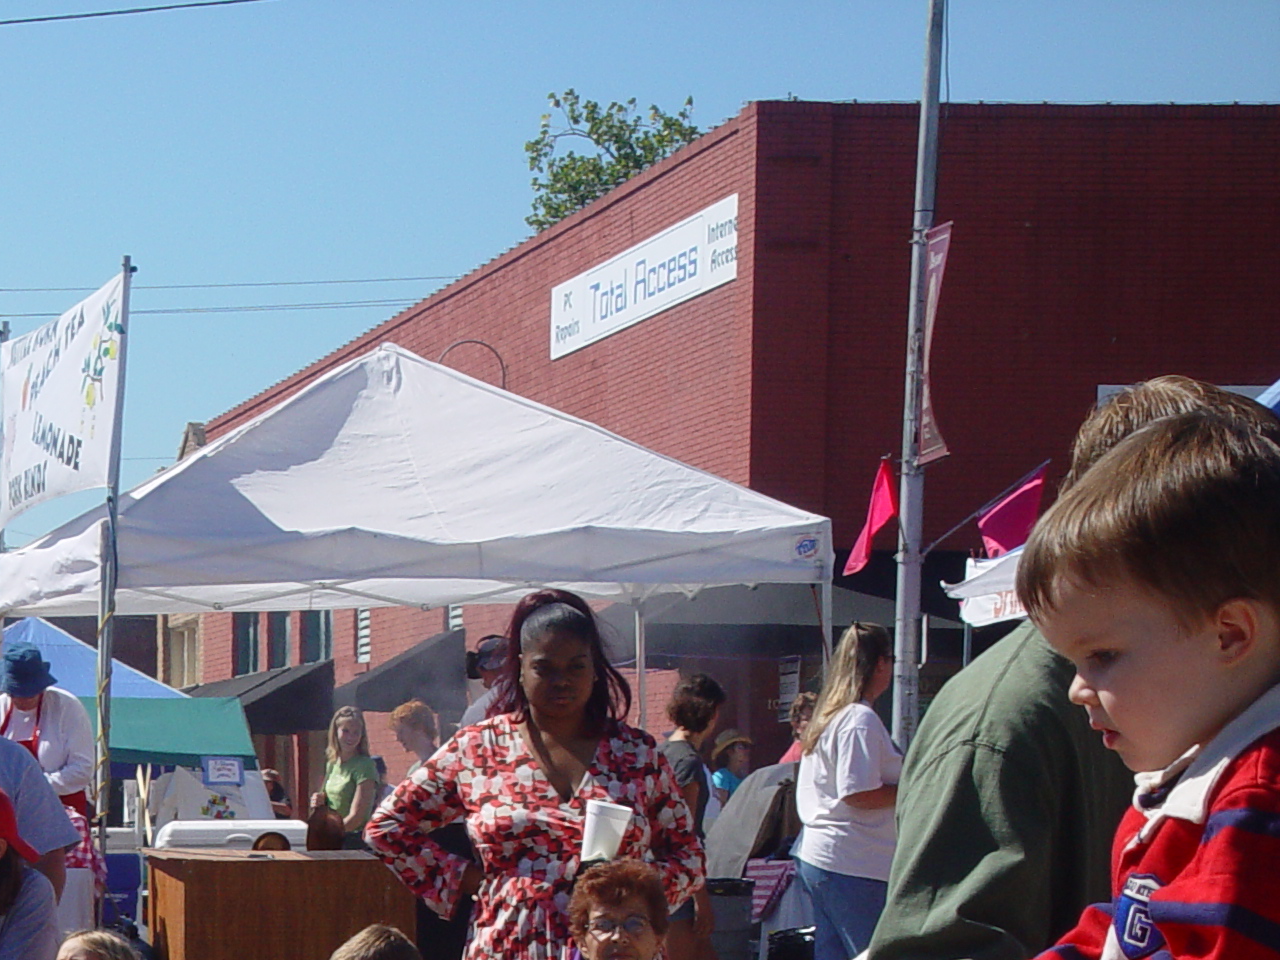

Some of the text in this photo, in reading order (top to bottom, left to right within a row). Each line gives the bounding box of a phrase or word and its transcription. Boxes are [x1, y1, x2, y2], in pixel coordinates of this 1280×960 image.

[589, 246, 698, 324] Total Access
[29, 304, 85, 411] PEACH TEA
[32, 410, 84, 472] LEMONADE
